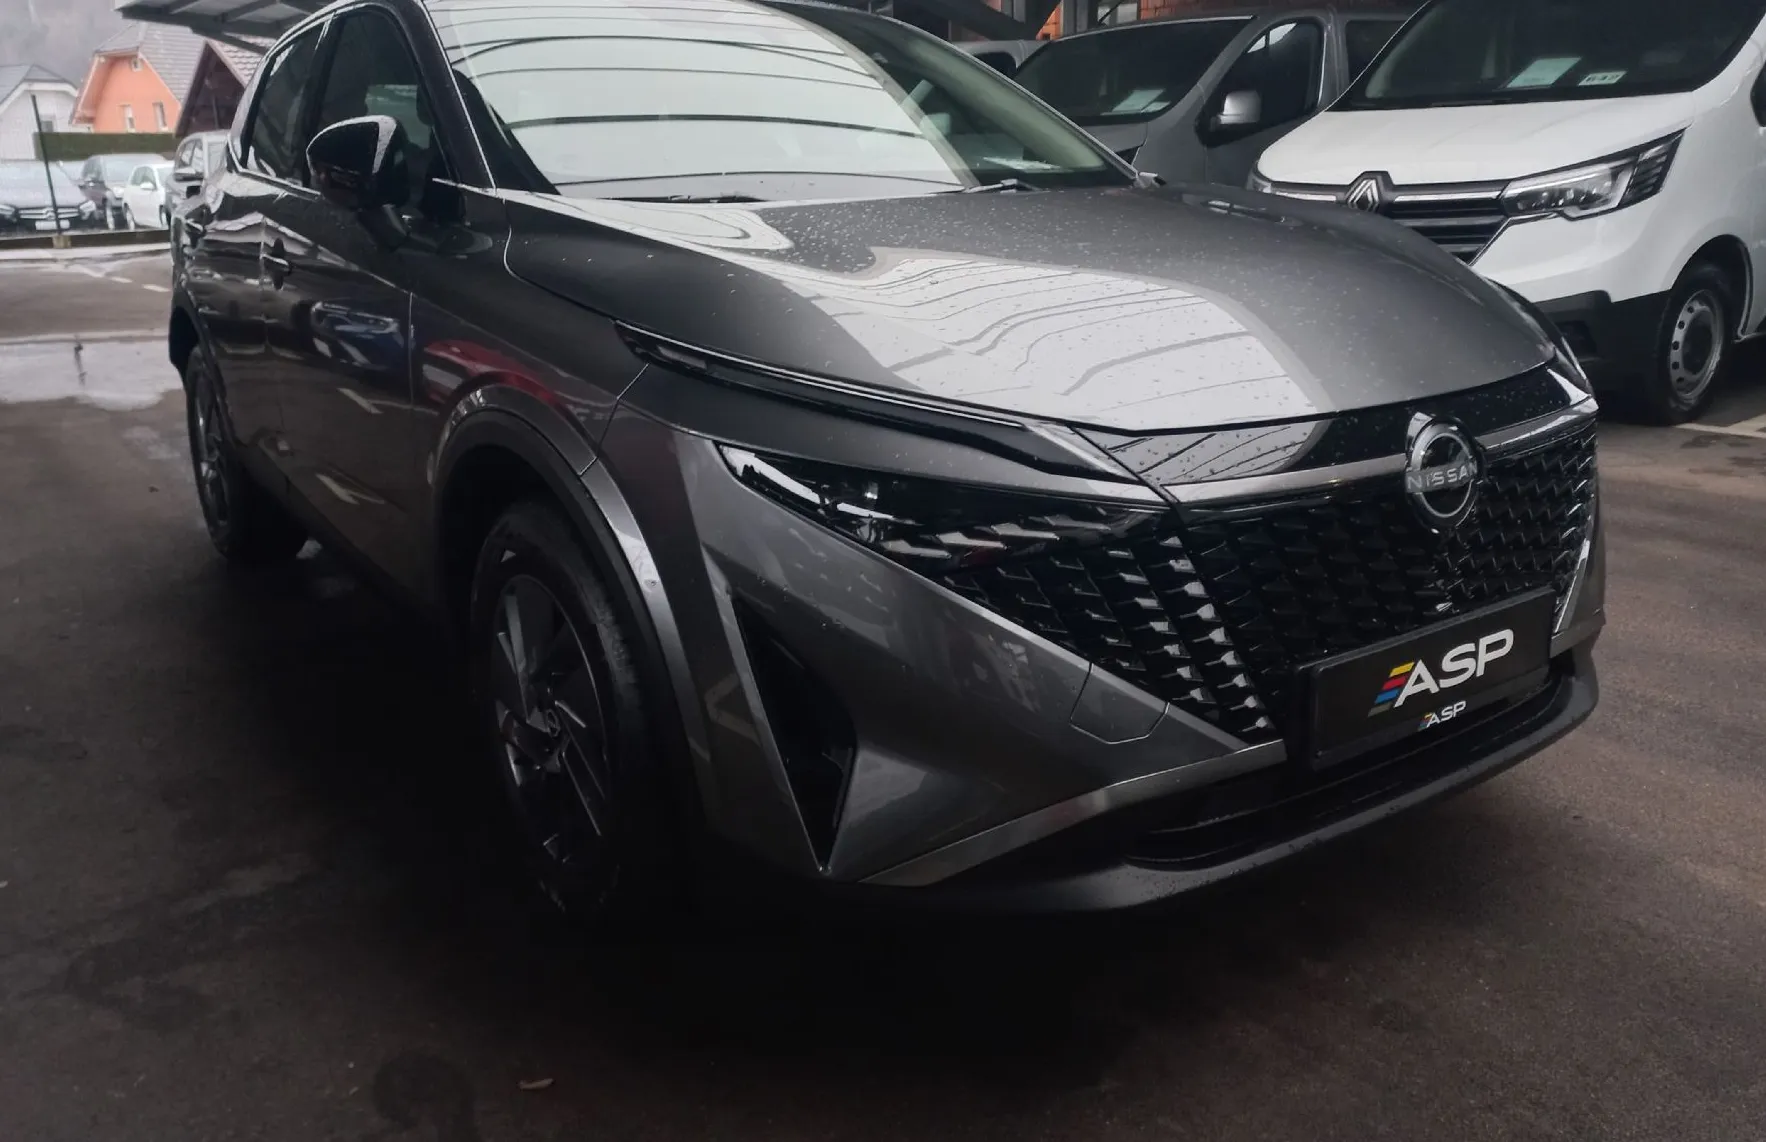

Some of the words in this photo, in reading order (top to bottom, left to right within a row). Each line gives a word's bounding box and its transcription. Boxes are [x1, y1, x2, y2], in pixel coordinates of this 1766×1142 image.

[1406, 461, 1477, 490] NISSAN
[1393, 628, 1514, 708] ASP
[1426, 700, 1467, 728] ASP
